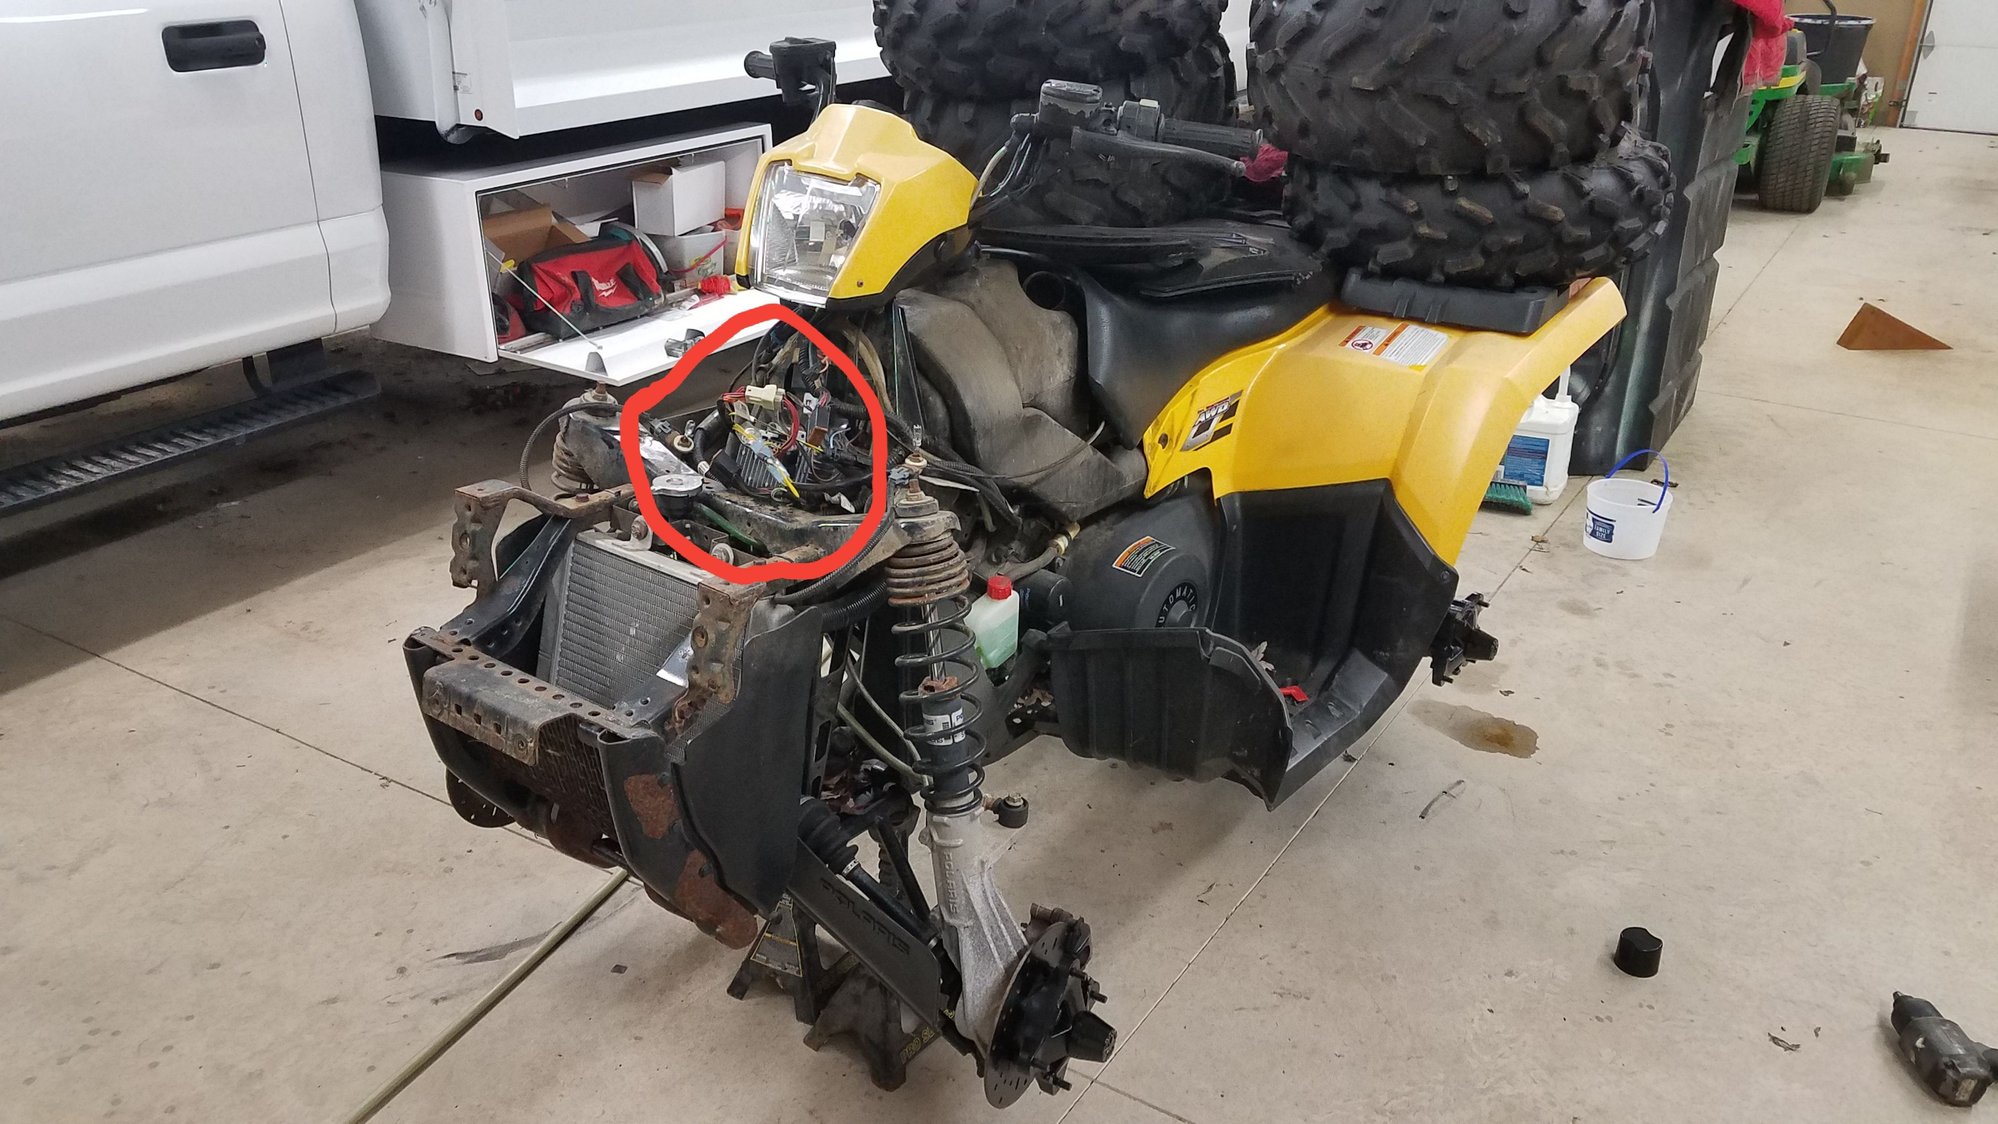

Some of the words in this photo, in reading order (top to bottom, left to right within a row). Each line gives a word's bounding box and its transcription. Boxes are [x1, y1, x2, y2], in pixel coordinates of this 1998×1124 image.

[1194, 401, 1229, 426] AWD
[1158, 585, 1197, 624] UTOMATIC
[943, 851, 958, 915] POLARIS
[820, 876, 910, 954] POLARIS
